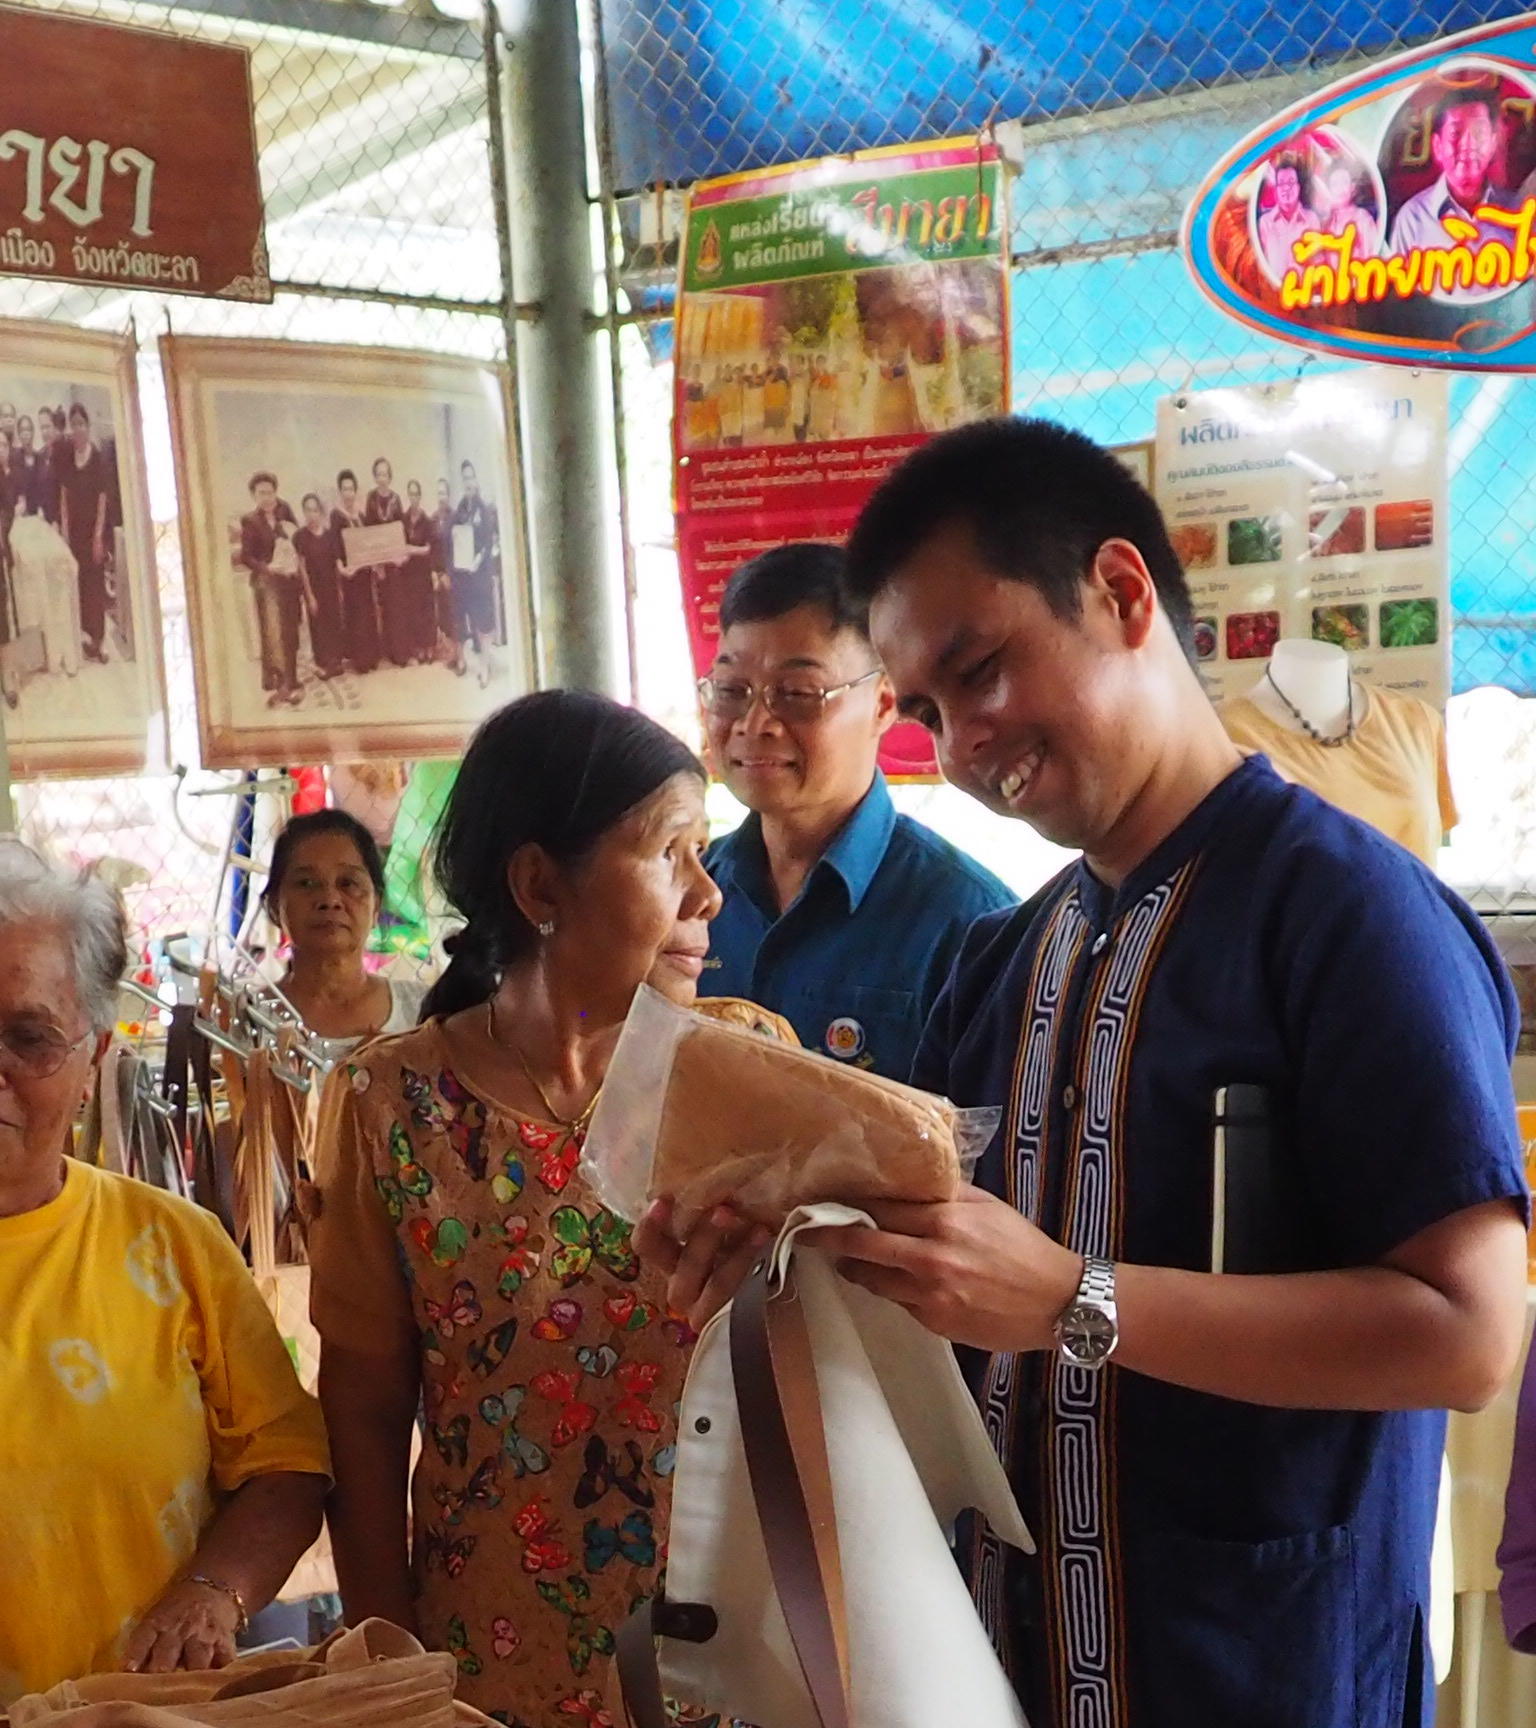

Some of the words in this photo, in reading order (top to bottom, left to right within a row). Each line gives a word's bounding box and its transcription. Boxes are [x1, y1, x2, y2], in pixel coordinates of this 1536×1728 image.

[70, 236, 200, 284] จังหวัดยะลา
